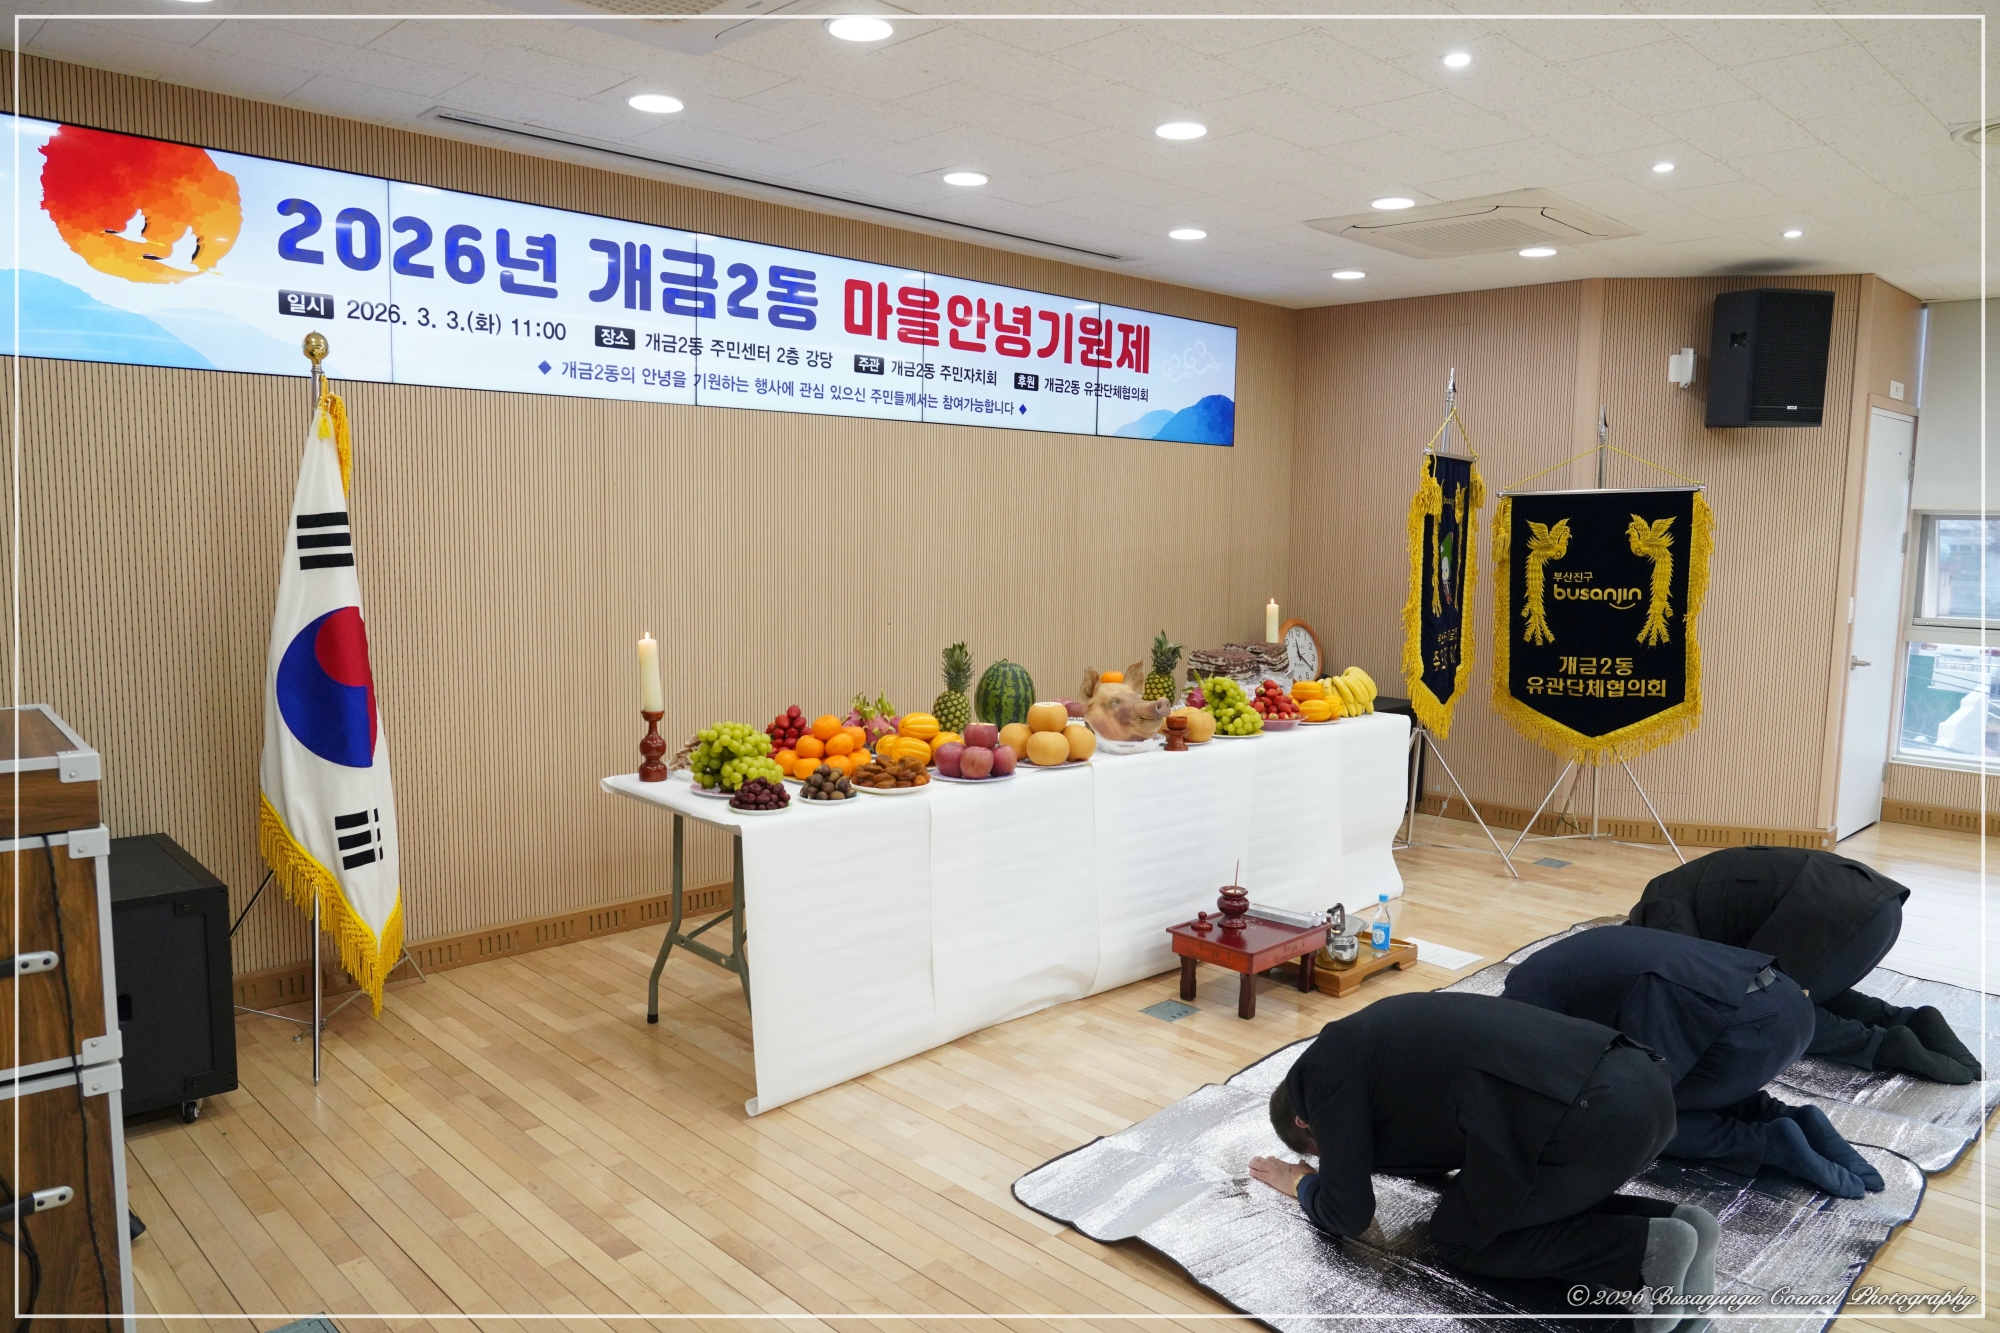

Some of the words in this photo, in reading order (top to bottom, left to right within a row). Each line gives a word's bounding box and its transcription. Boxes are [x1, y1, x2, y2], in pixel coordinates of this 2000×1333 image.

[276, 197, 559, 299] 2026년
[588, 238, 819, 332] 개금2동
[844, 278, 1150, 374] 마을안녕기원제
[286, 293, 325, 315] 일시
[346, 300, 407, 326] 2026.
[417, 307, 437, 328] 3.
[446, 310, 502, 336] 3.(화)
[511, 318, 567, 341] 11:00
[600, 327, 630, 347] 장소
[645, 332, 704, 356] 개금2동
[710, 339, 771, 363] 주민센터
[776, 347, 800, 366] 2층
[806, 350, 834, 369] 강당
[857, 356, 881, 373] 주관
[891, 360, 936, 381] 개금2동
[939, 363, 998, 386] 주민자치회
[1017, 374, 1035, 389] 후원
[1044, 376, 1081, 395] 개금2동
[1083, 381, 1149, 402] 유관단체협의회
[561, 361, 635, 384] 개금2동의
[642, 368, 687, 389] 안녕을
[693, 372, 750, 394] 기원하는
[754, 377, 794, 397] 행사에
[799, 382, 825, 400] 관심
[830, 384, 866, 404] 있으신
[870, 387, 939, 409] 주민들께서는
[942, 394, 1014, 416] 참여가능합니다
[1552, 571, 1594, 583] 부산진구
[1553, 583, 1642, 605] busanjin
[1558, 656, 1634, 676] 개금2동
[1526, 676, 1667, 698] 유관단체협의회
